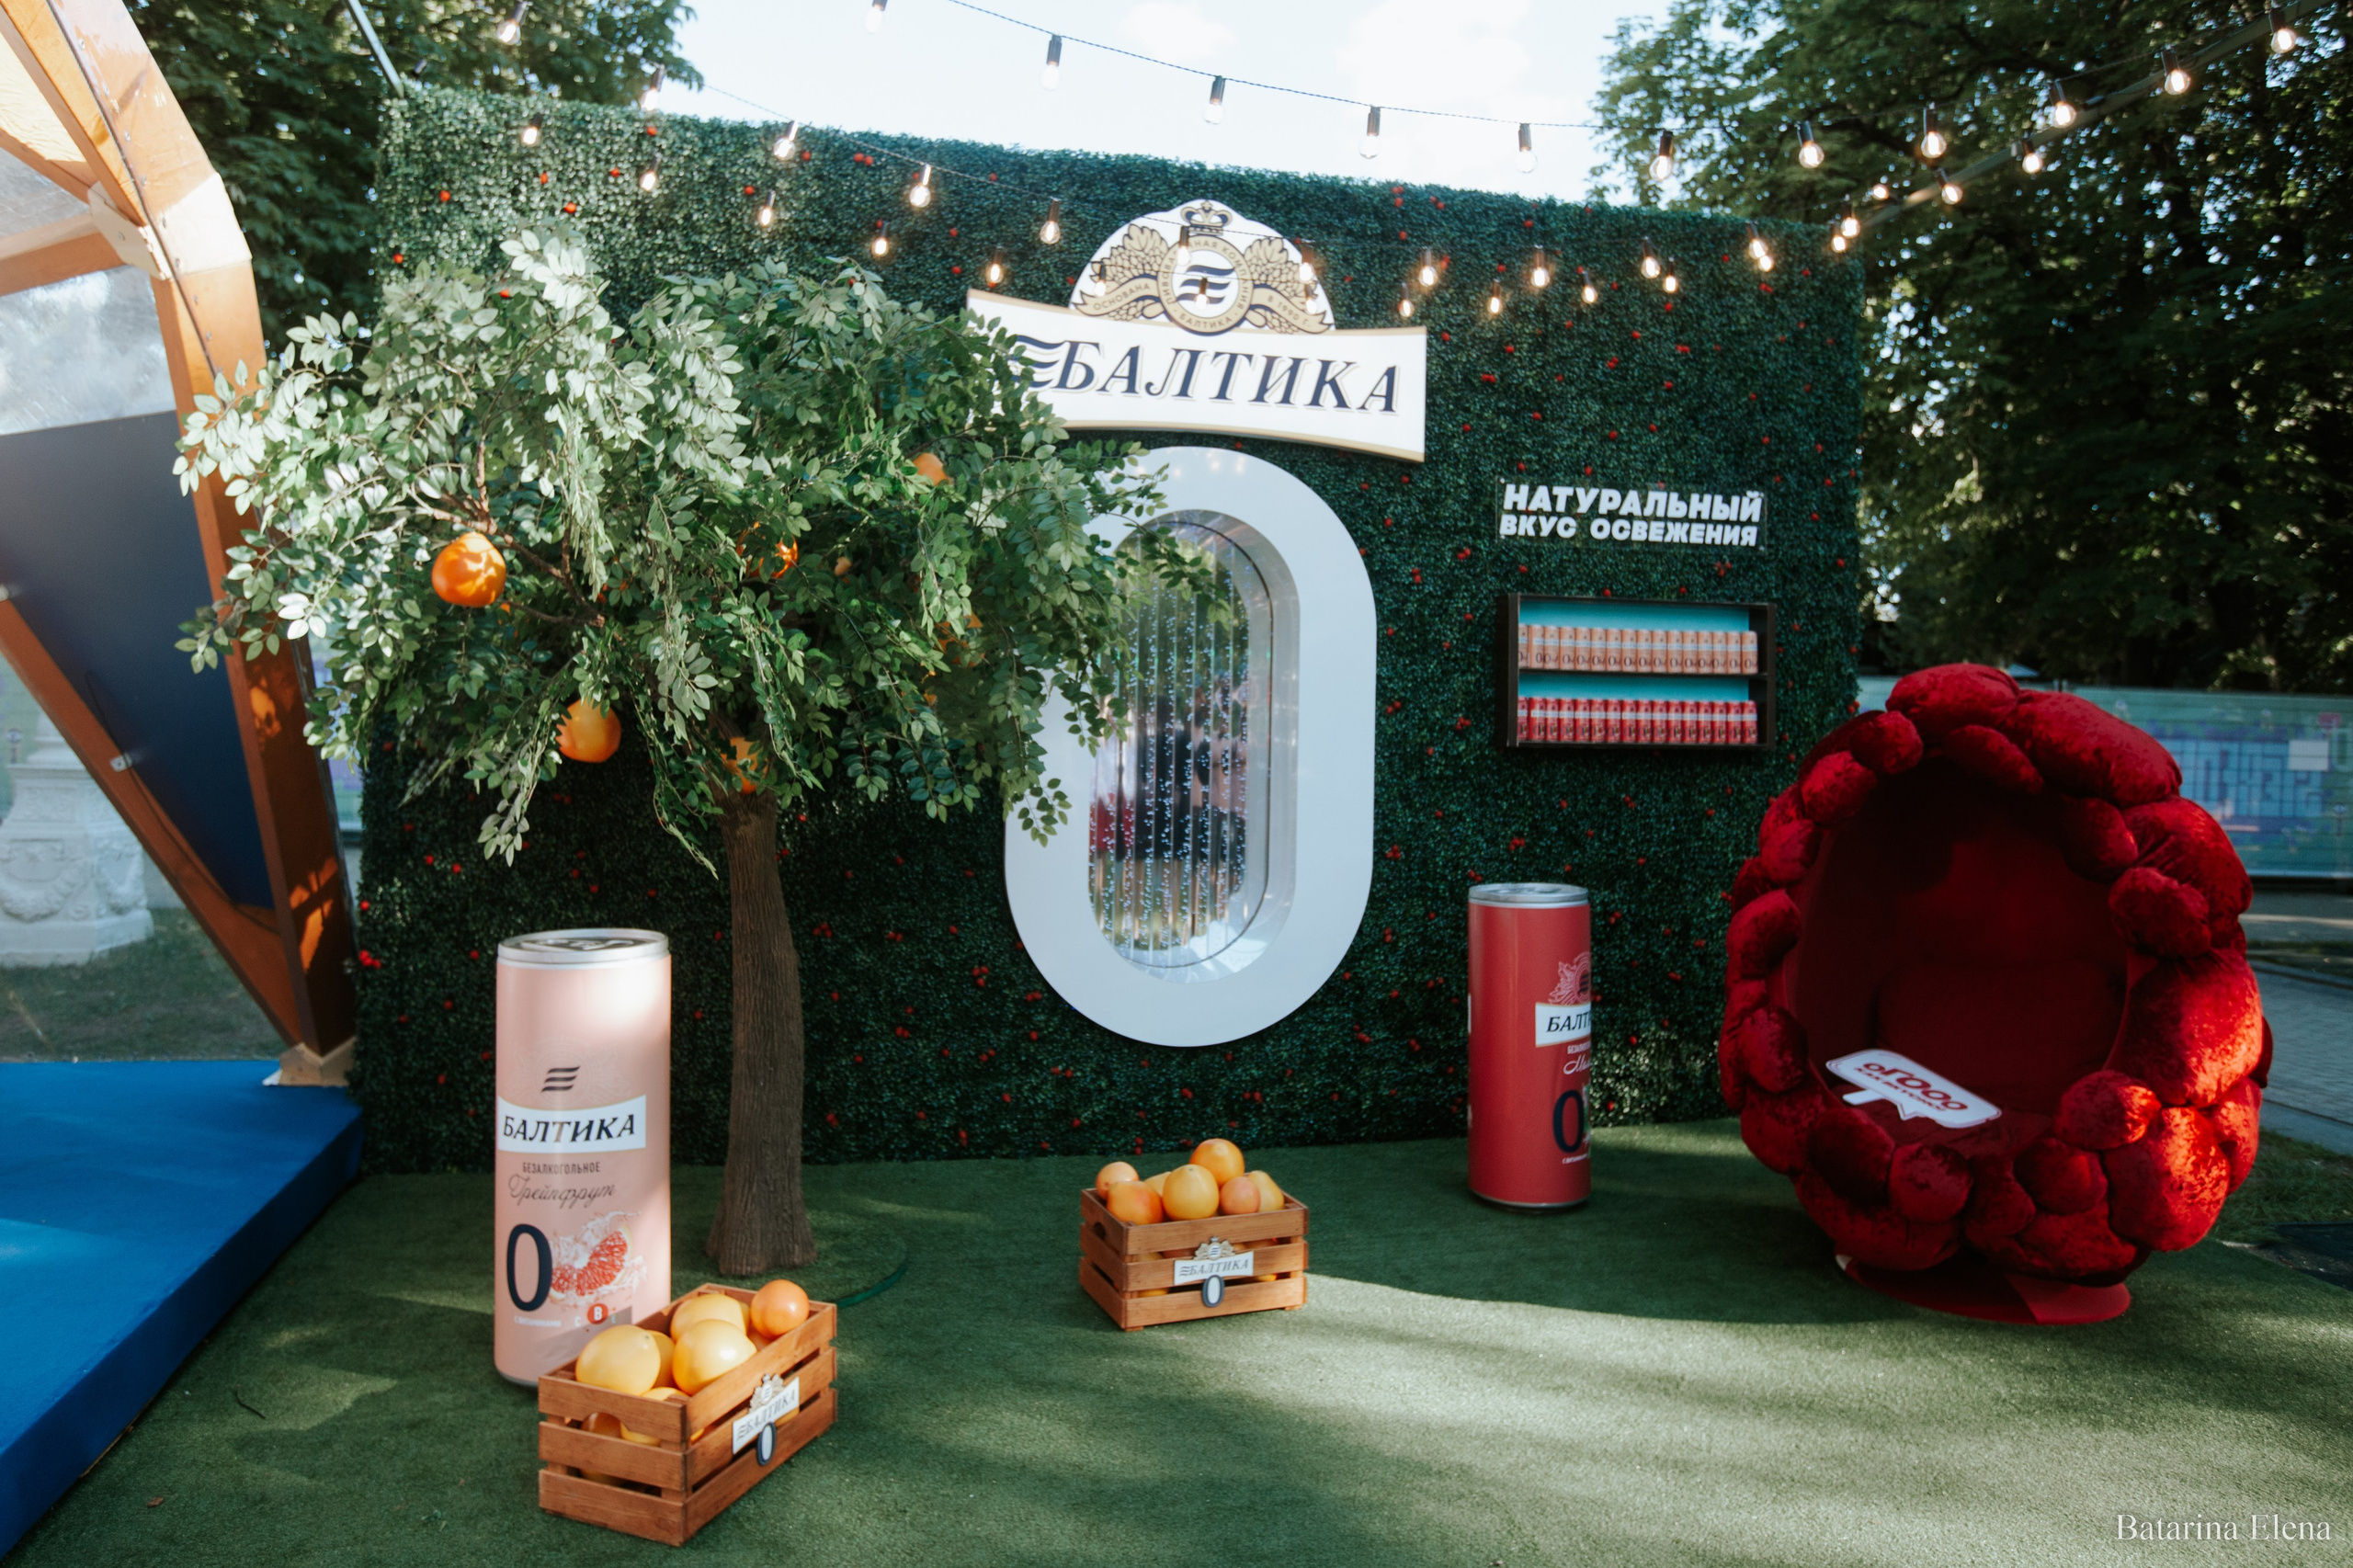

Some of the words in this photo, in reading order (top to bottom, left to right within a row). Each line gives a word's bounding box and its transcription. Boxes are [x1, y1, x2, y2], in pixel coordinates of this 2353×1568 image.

[1093, 283, 1150, 311] ОСНОВАНА
[1179, 312, 1233, 329] БАЛТИКА
[1053, 339, 1400, 415] БАЛТИКА
[1503, 483, 1763, 523] НАТУРАЛЬНЫЙ
[1499, 514, 1577, 539] ВКУС
[1590, 517, 1759, 547] ОСВЕЖЕНИЯ
[1547, 1011, 1591, 1033] БАЛТ
[503, 1114, 636, 1143] БАЛТИКА
[1553, 1090, 1584, 1153] 0
[522, 1161, 601, 1176] БЕЗАЛКОГОЛЬНОЕ
[508, 1174, 616, 1210] Грейпфрут
[506, 1223, 552, 1312] 0
[1189, 1259, 1248, 1276] БАЛТИКА
[1202, 1274, 1225, 1308] 0
[756, 1421, 776, 1466] 0
